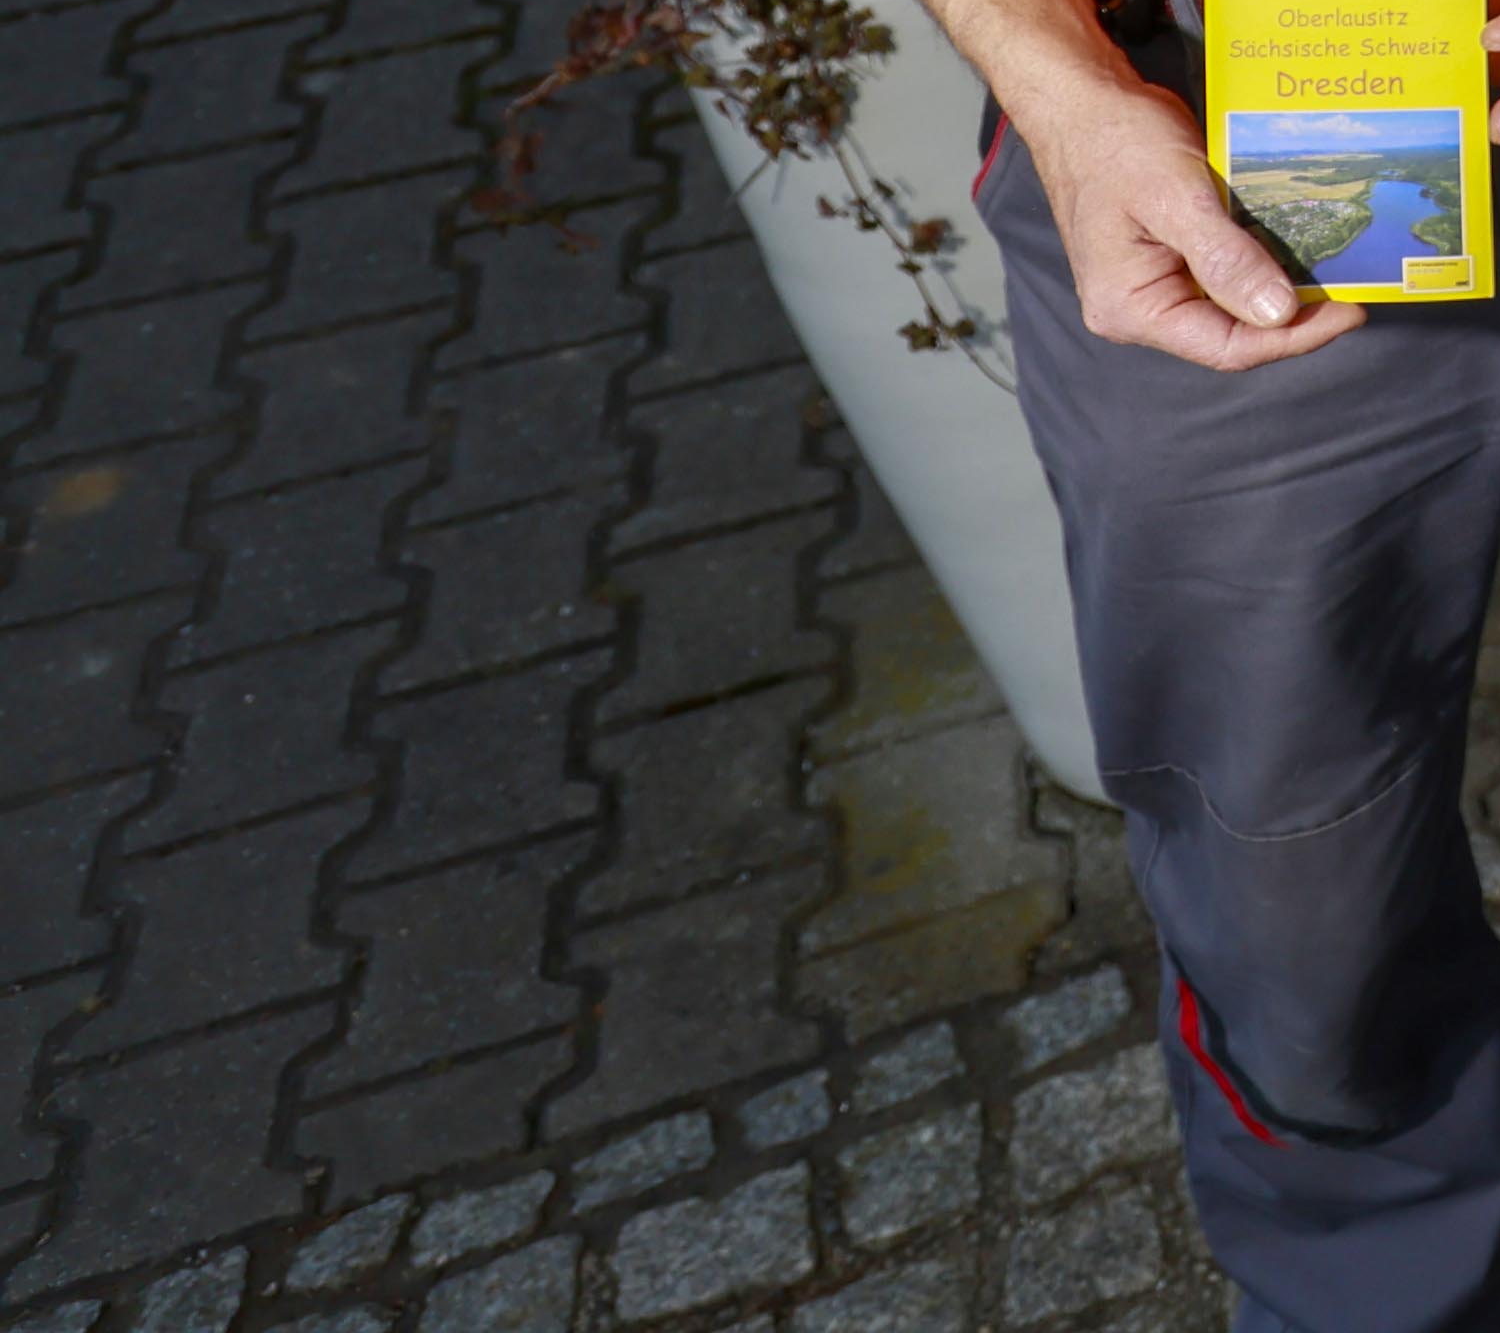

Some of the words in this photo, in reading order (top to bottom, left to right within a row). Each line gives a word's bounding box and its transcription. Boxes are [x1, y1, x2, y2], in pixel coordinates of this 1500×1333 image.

[1278, 8, 1408, 28] Oberlausitz
[1229, 38, 1350, 59] Sächsische
[1360, 37, 1450, 57] Schweiz
[1276, 69, 1405, 98] Dresden
